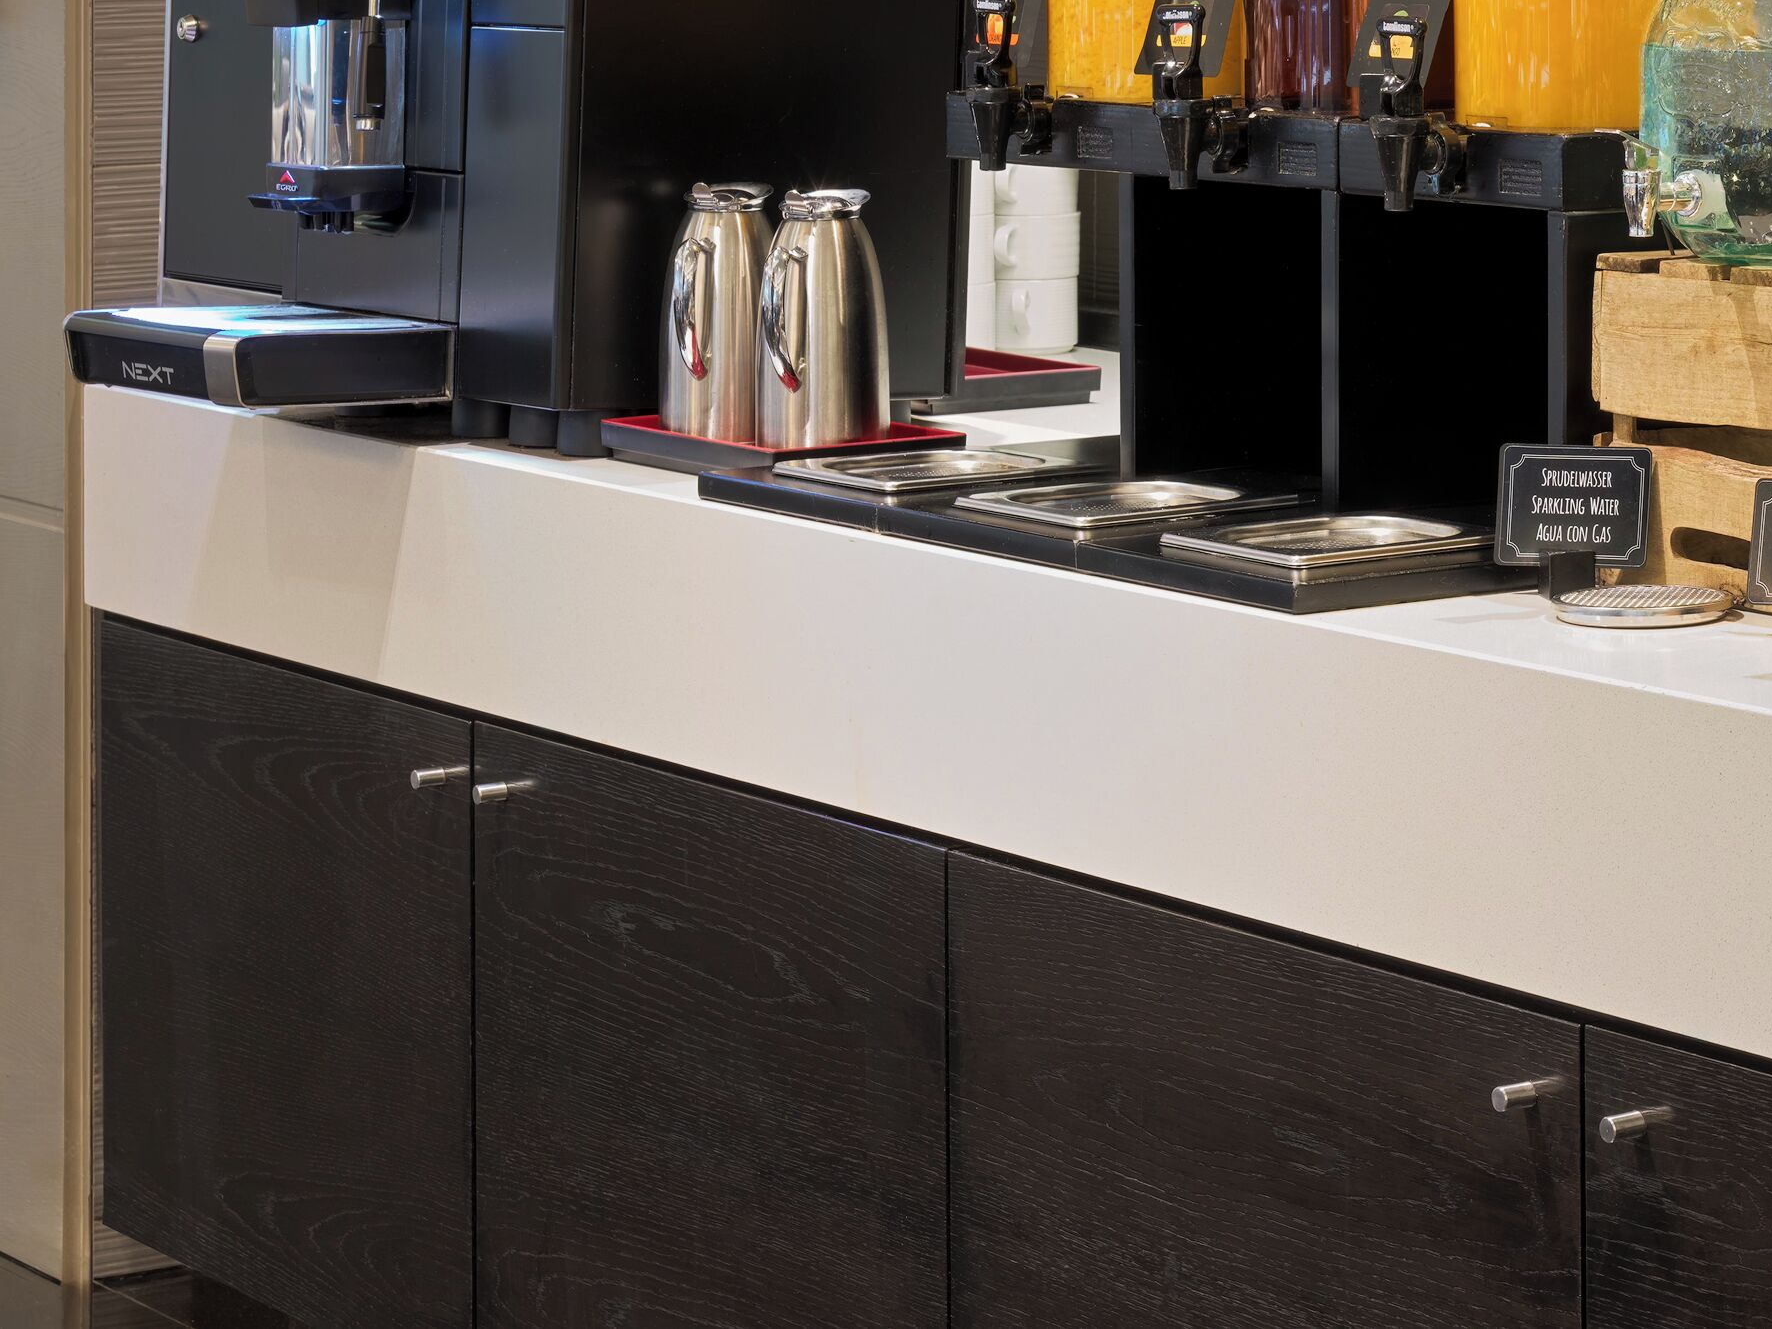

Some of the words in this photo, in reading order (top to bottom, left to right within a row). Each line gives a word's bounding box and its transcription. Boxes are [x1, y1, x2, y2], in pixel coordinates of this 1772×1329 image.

[1173, 36, 1188, 45] APPLE
[276, 183, 298, 192] EGRO
[121, 360, 175, 385] NEXT
[1541, 468, 1612, 488] SPRUDELWASSER
[1531, 495, 1585, 515] SPARKLING
[1590, 496, 1619, 516] WATER
[1536, 523, 1562, 542] AGUA
[1567, 525, 1588, 542] CON
[1592, 524, 1611, 543] GAS
